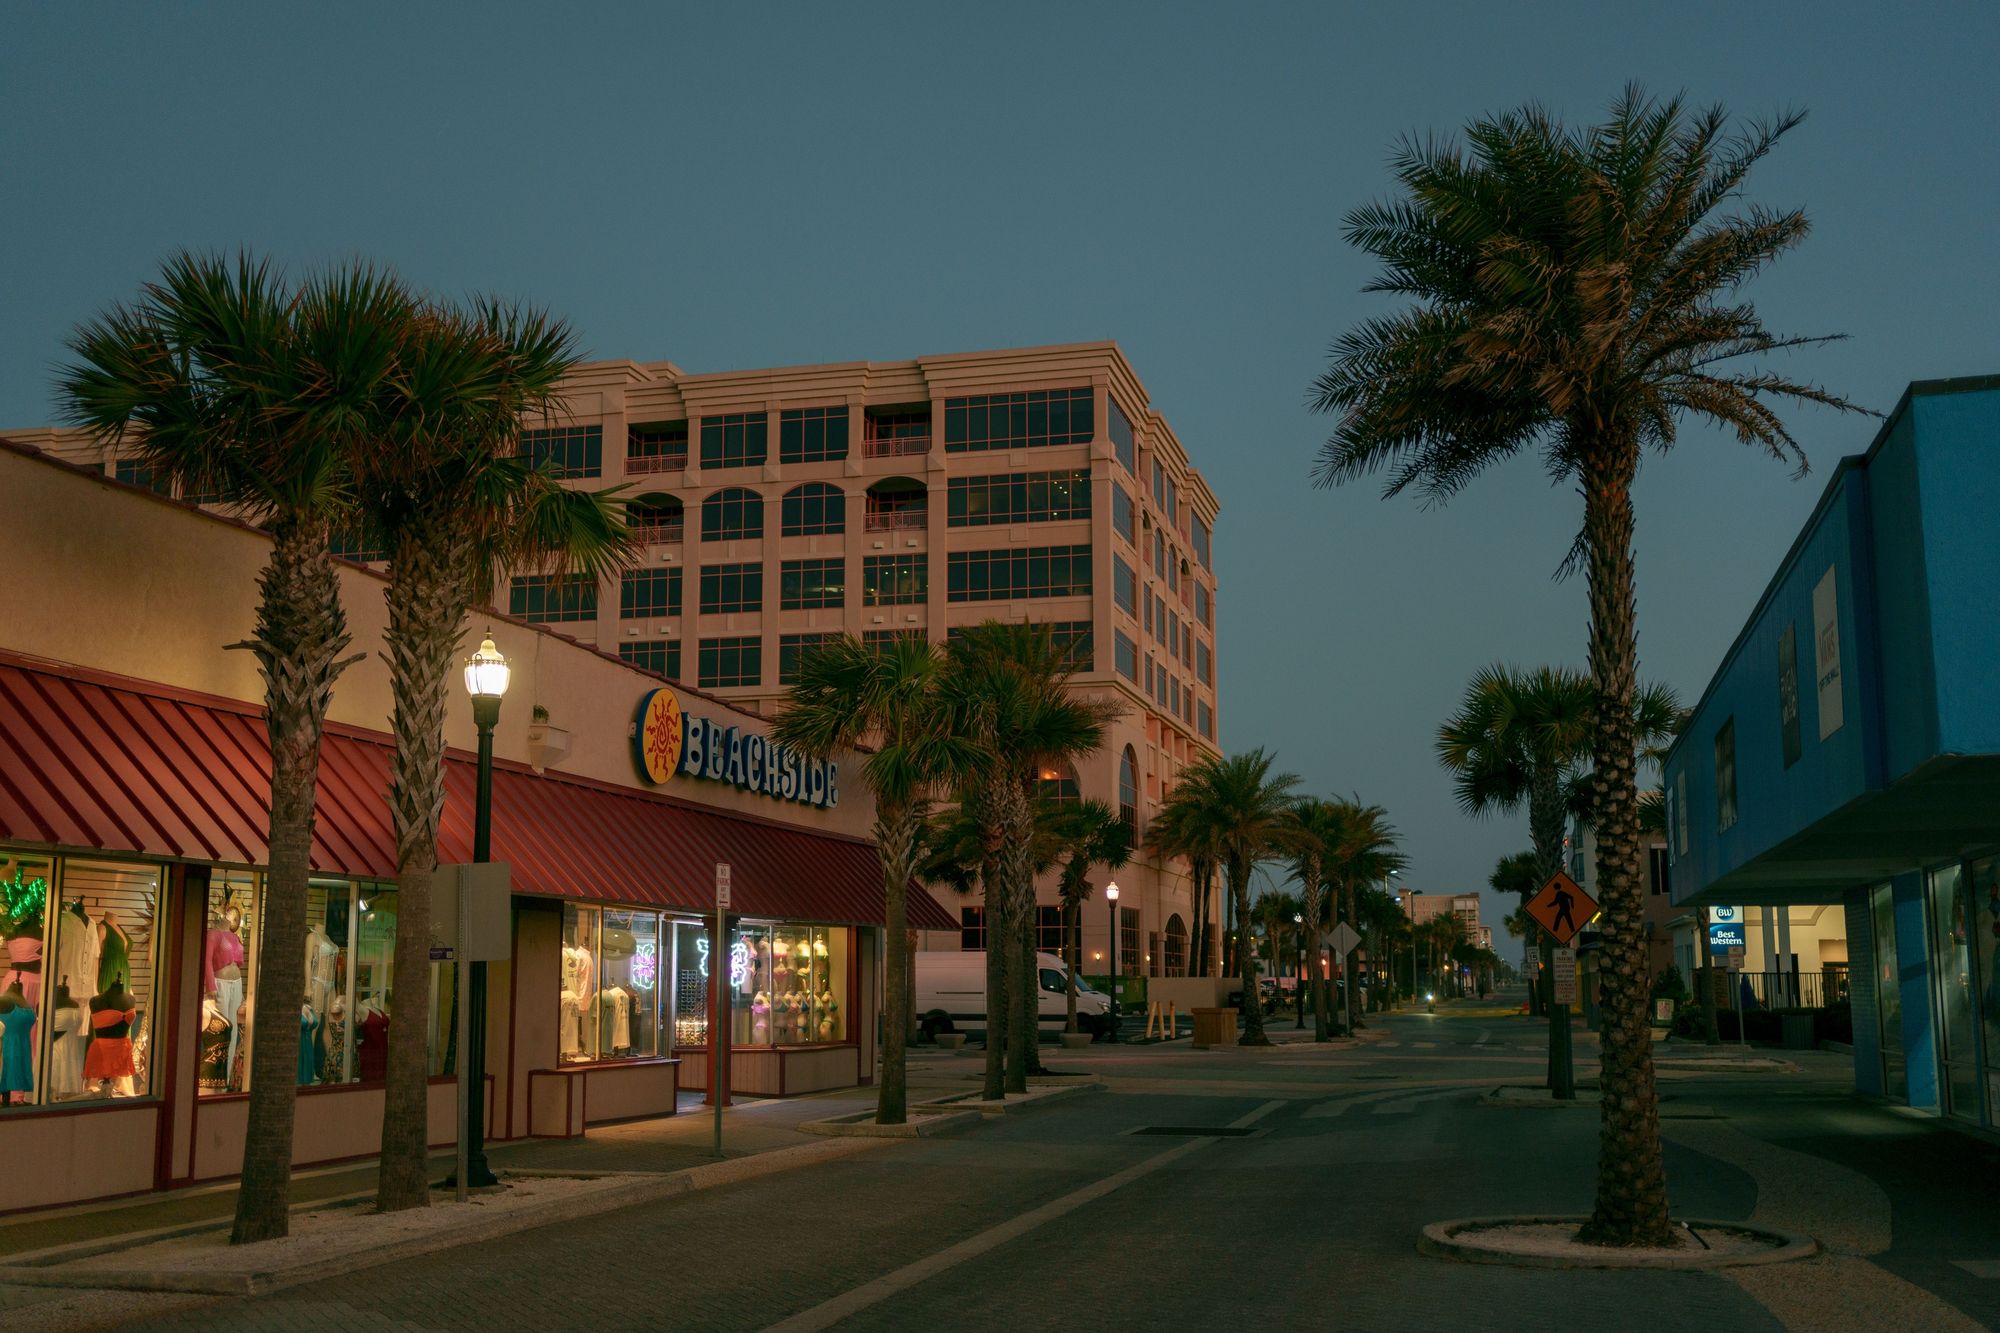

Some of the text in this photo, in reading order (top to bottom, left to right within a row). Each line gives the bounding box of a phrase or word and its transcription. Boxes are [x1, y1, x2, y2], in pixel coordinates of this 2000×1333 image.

[681, 712, 839, 809] BEACHSIDE
[1718, 908, 1733, 917] BW
[1717, 930, 1735, 938] Best
